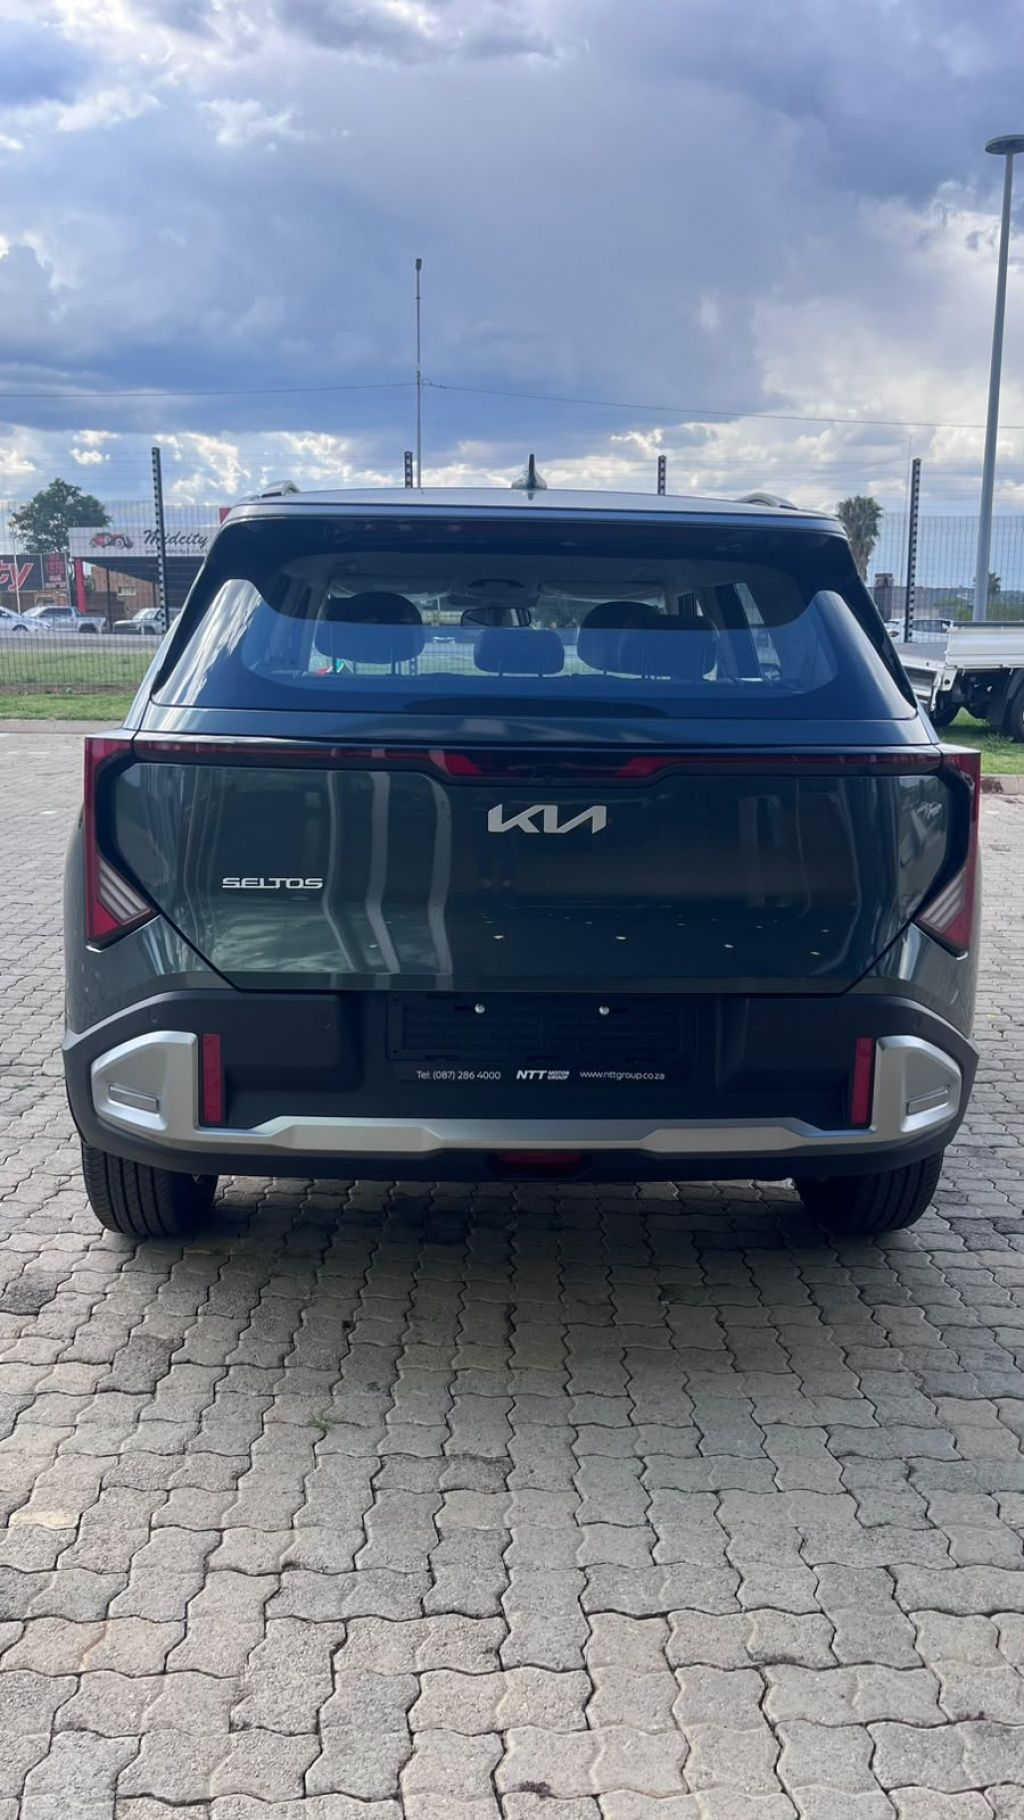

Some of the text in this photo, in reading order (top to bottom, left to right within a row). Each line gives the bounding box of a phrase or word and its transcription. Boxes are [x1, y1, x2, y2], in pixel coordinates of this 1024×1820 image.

[488, 803, 606, 834] KIA
[222, 877, 323, 889] SELTOS
[432, 1070, 456, 1081] (087)
[457, 1071, 475, 1080] 286
[477, 1071, 502, 1080] 4000
[516, 1070, 547, 1080] NTT
[580, 1071, 665, 1081] www.nttgroup.co.za
